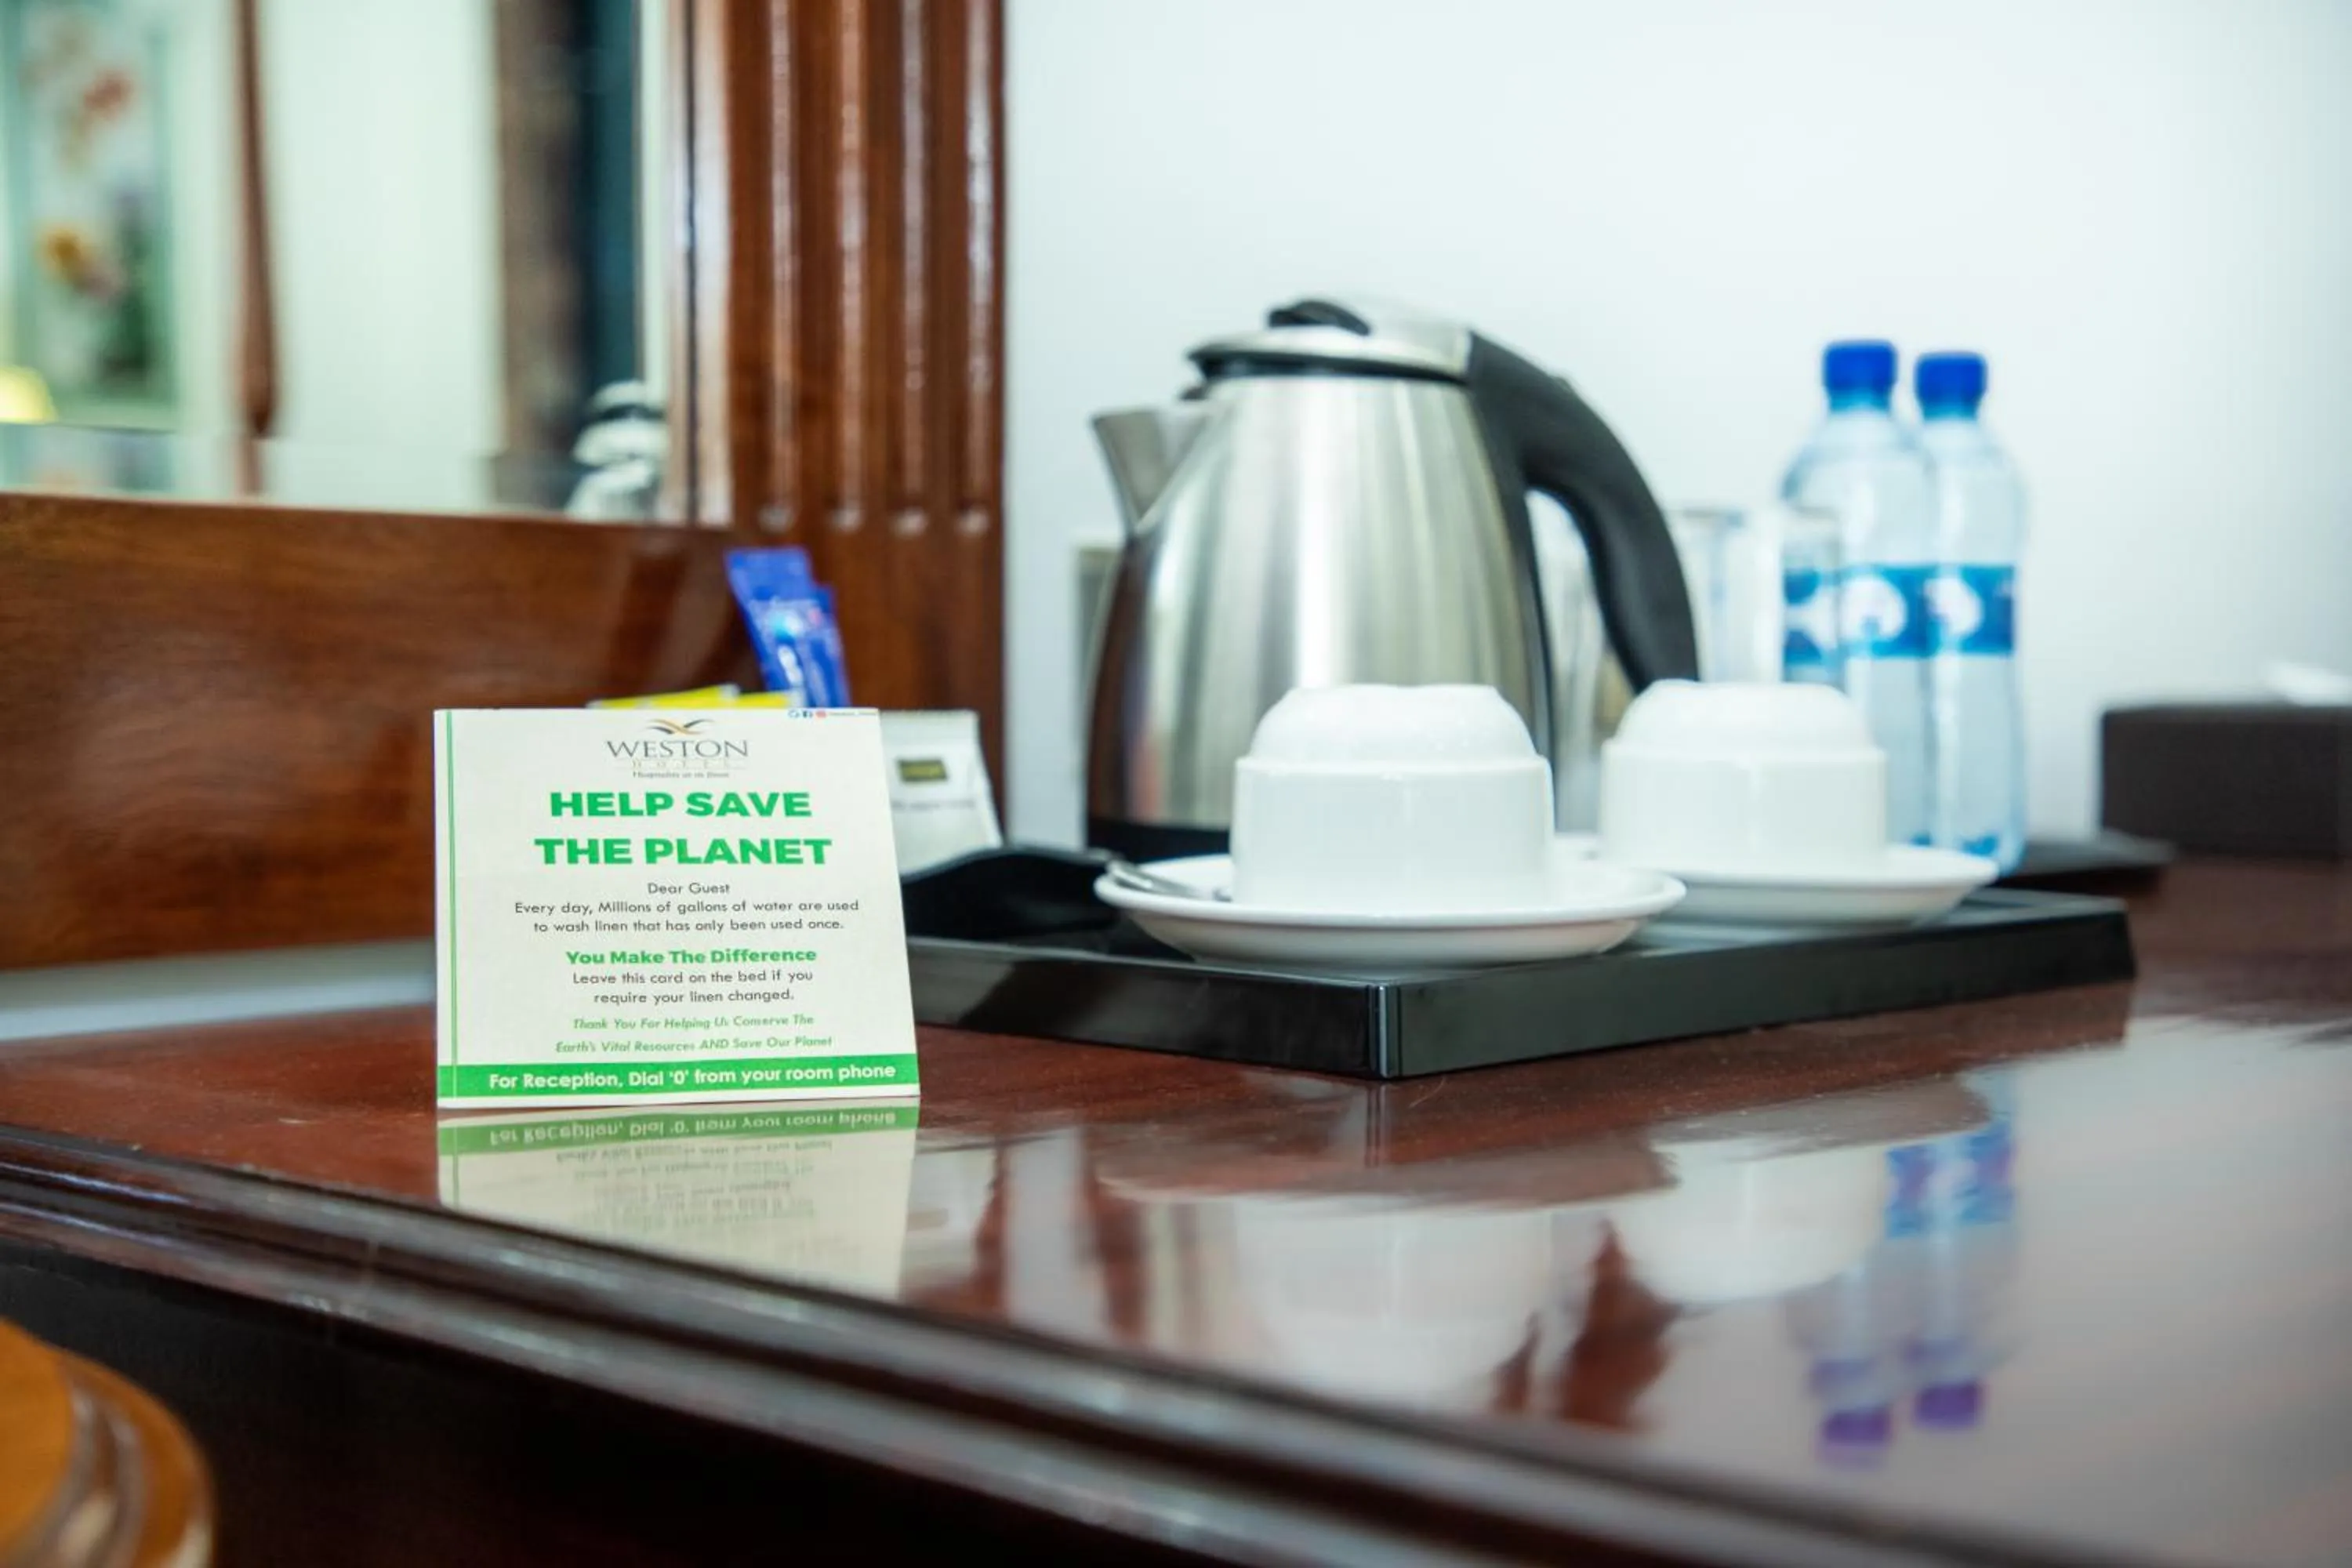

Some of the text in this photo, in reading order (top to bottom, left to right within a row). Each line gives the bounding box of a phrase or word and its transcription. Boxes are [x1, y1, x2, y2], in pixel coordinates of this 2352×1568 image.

[607, 739, 749, 758] WESTON
[550, 792, 812, 817] HELP SAVE
[535, 838, 833, 864] THE PLANET
[648, 883, 731, 894] Dear Guest
[515, 899, 859, 915] Every day, Millions of gallons of water are used
[534, 918, 844, 933] to wash linen that has only been used once.
[566, 948, 817, 964] You Make The Difference
[572, 969, 813, 984] Leave this card on the bed if you
[593, 989, 795, 1006] require your linen changed.
[573, 1018, 607, 1029] Thank
[613, 1018, 637, 1029] You
[640, 1018, 660, 1029] For
[664, 1017, 711, 1031] Helping
[733, 1015, 789, 1027] Conserve
[792, 1014, 814, 1025] The
[555, 1036, 833, 1053] Earth's Vital Resources AND Save Our Planet
[488, 1073, 517, 1089] For
[522, 1071, 623, 1090] Reception,
[629, 1070, 664, 1086] Dial
[695, 1068, 736, 1084] from
[741, 1069, 782, 1085] your
[786, 1066, 834, 1081] room
[838, 1063, 896, 1081] phone
